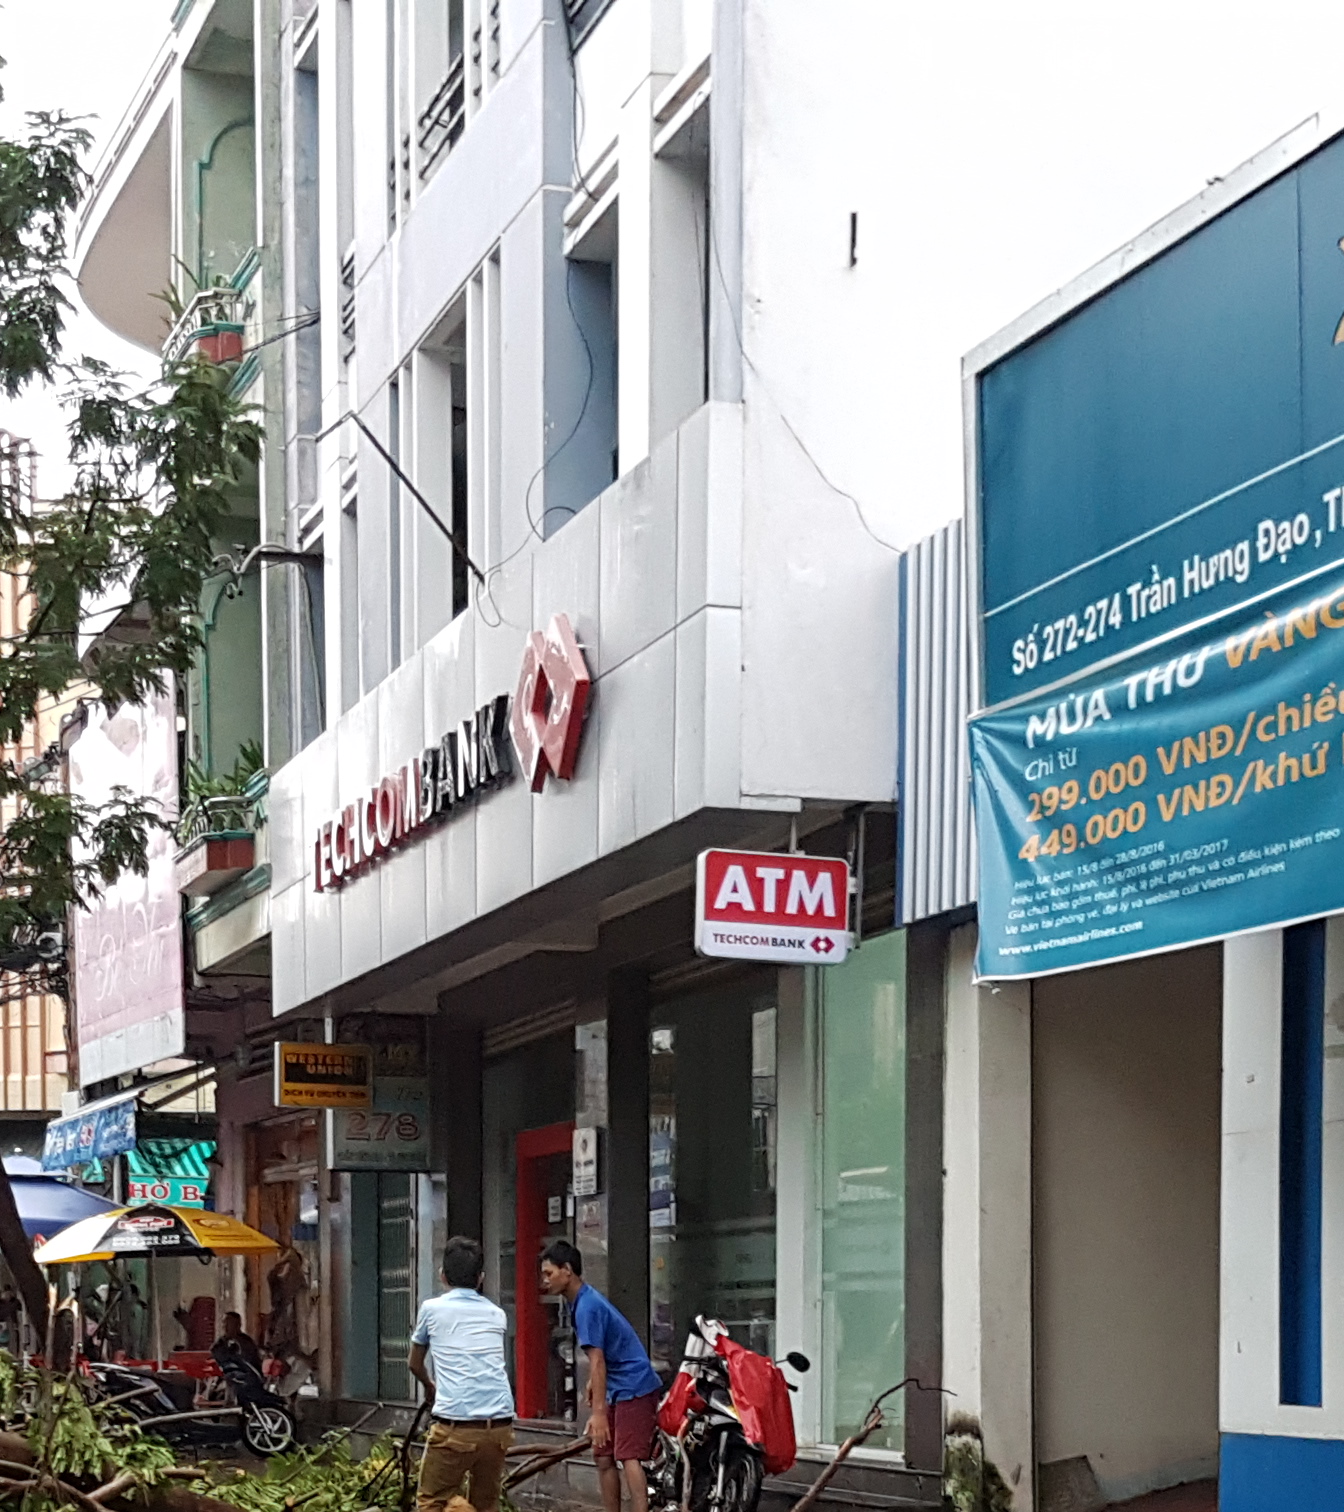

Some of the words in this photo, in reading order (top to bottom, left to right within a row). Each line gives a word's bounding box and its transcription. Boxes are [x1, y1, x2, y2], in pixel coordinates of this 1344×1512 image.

[1012, 623, 1039, 676] Số
[1043, 592, 1123, 663] 272-274
[1127, 564, 1177, 623] Trần
[1183, 539, 1250, 598] Hưng
[1025, 687, 1112, 749] MÙA
[314, 693, 510, 893] TECHCOMBANK
[1018, 801, 1147, 862] 449.000
[1156, 741, 1329, 823] VNĐ/khứ
[1026, 755, 1148, 823] 299.000
[1168, 838, 1229, 866] 31/03/2017
[713, 864, 837, 918] ATM
[712, 932, 807, 950] TECHCOMBANK
[285, 1053, 354, 1066] WESTERN
[306, 1064, 354, 1076] UNION
[345, 1111, 421, 1142] 278
[181, 1185, 201, 1201] B
